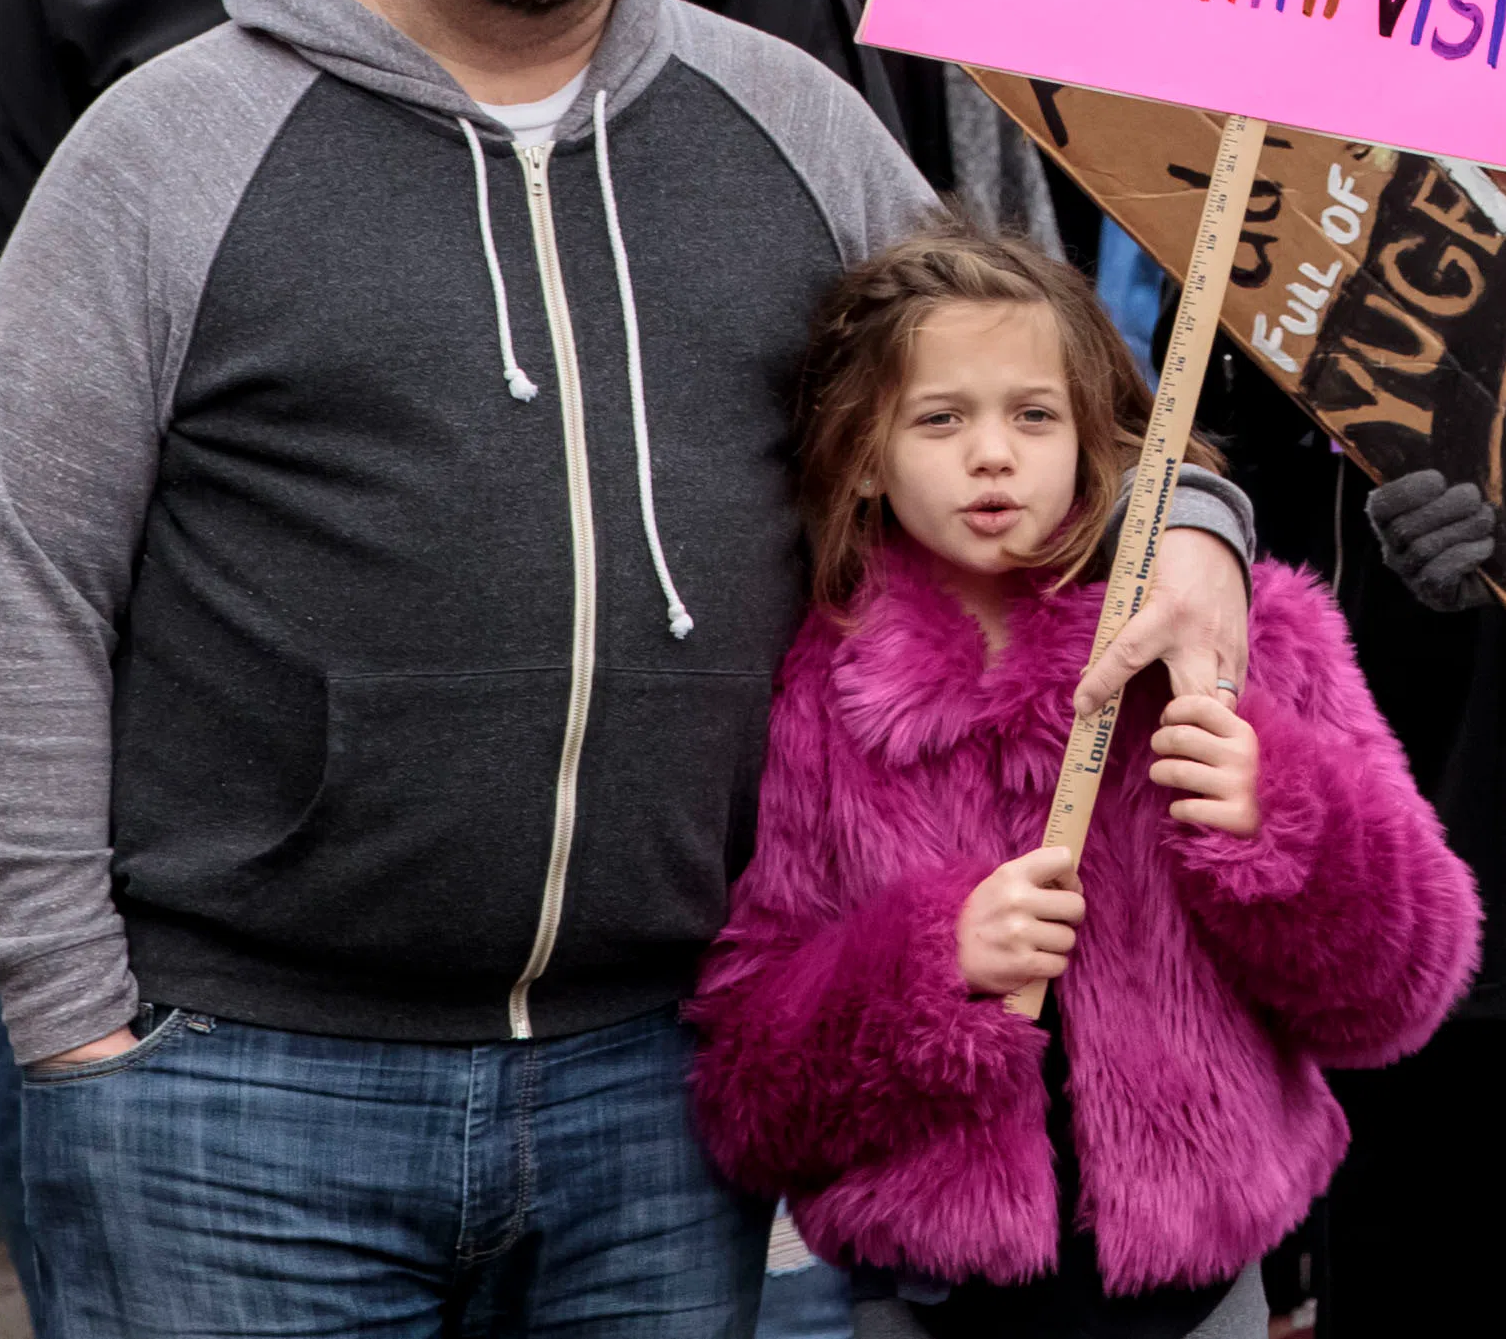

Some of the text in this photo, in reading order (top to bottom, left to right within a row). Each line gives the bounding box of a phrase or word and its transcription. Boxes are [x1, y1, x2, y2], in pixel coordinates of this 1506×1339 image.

[1215, 193, 1229, 214] 20
[1205, 233, 1218, 252] 19
[1249, 258, 1344, 375] FULL
[1319, 162, 1371, 248] OF
[1195, 274, 1207, 292] 18
[1185, 315, 1198, 334] 17
[1175, 355, 1187, 373] 16
[1165, 396, 1177, 414] 15
[1144, 477, 1156, 495] 13
[1134, 455, 1177, 582] Improvement
[1113, 599, 1126, 617] 10
[1083, 704, 1117, 774] LOWE'S
